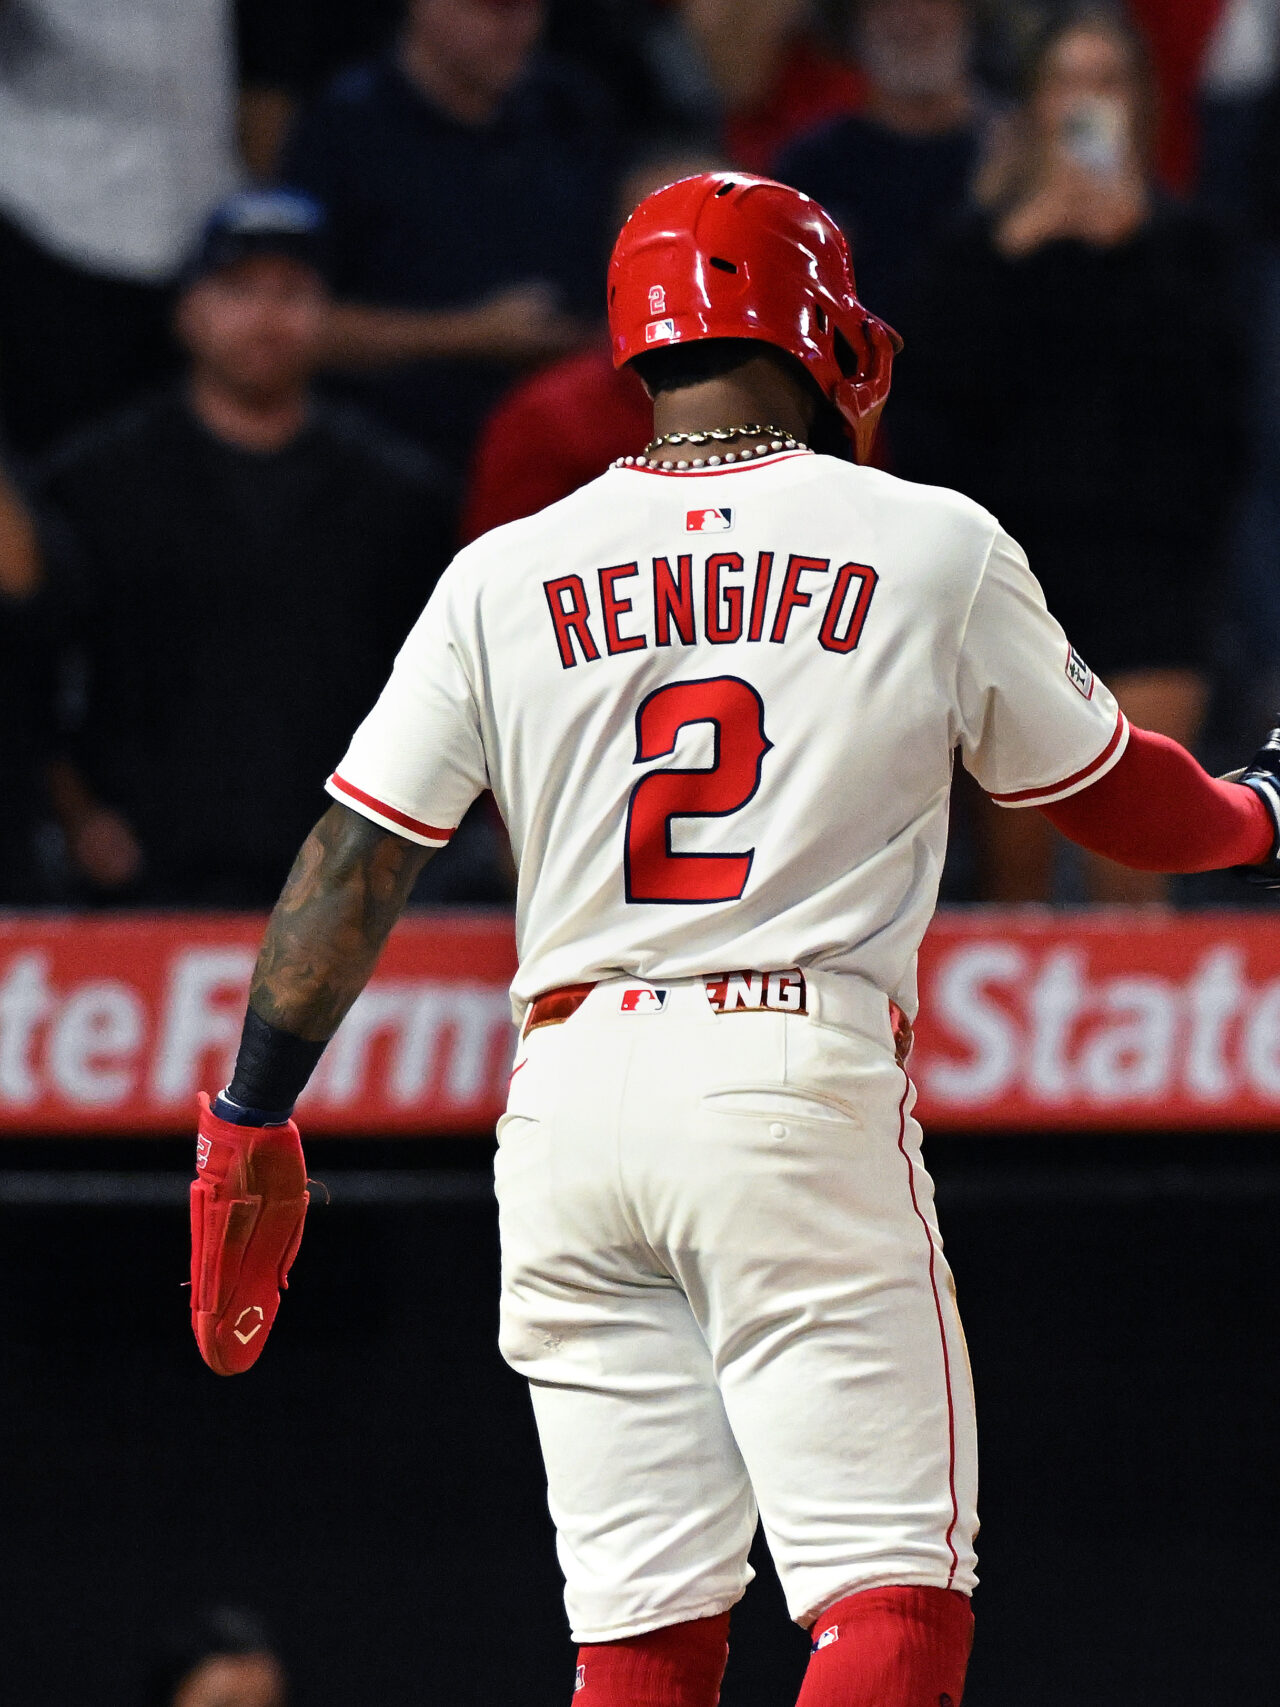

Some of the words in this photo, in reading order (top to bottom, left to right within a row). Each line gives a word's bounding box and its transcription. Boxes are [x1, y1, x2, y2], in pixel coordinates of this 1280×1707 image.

[648, 284, 666, 315] 2
[543, 550, 879, 669] RENGIFO
[624, 675, 774, 904] 2
